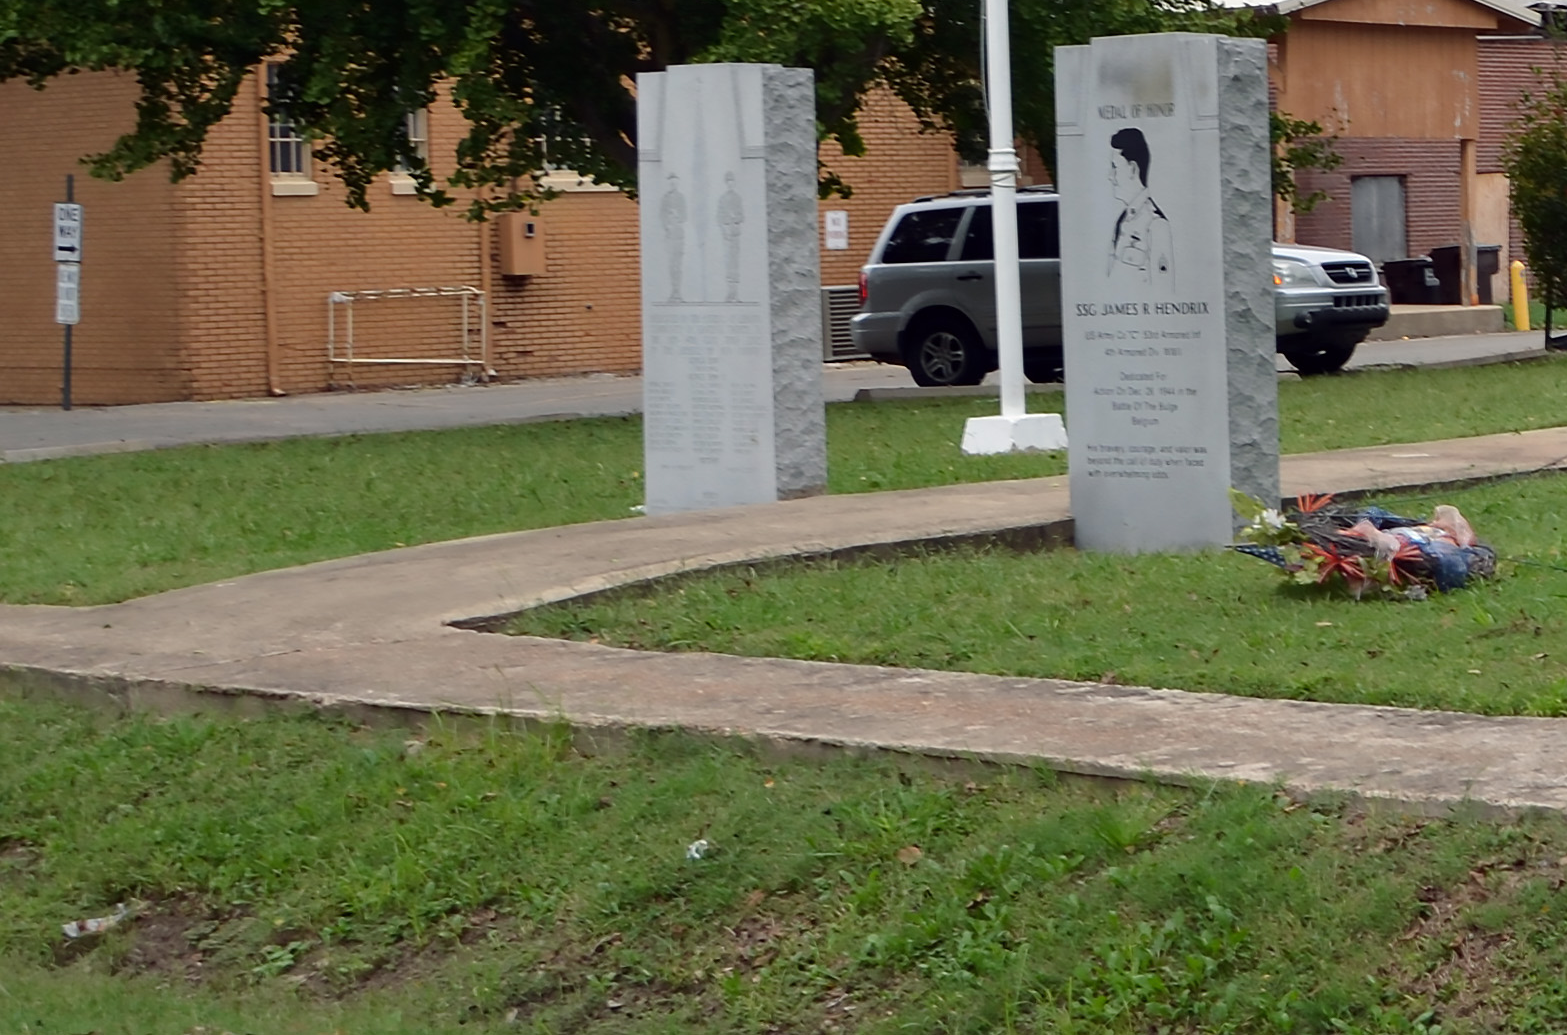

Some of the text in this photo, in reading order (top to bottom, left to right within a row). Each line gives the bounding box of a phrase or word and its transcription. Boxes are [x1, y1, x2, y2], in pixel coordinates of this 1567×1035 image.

[59, 208, 79, 222] ONE
[58, 225, 77, 238] WAY
[1076, 303, 1096, 316] SSG
[1101, 303, 1138, 315] JAMES
[1156, 301, 1210, 315] HENDRIX
